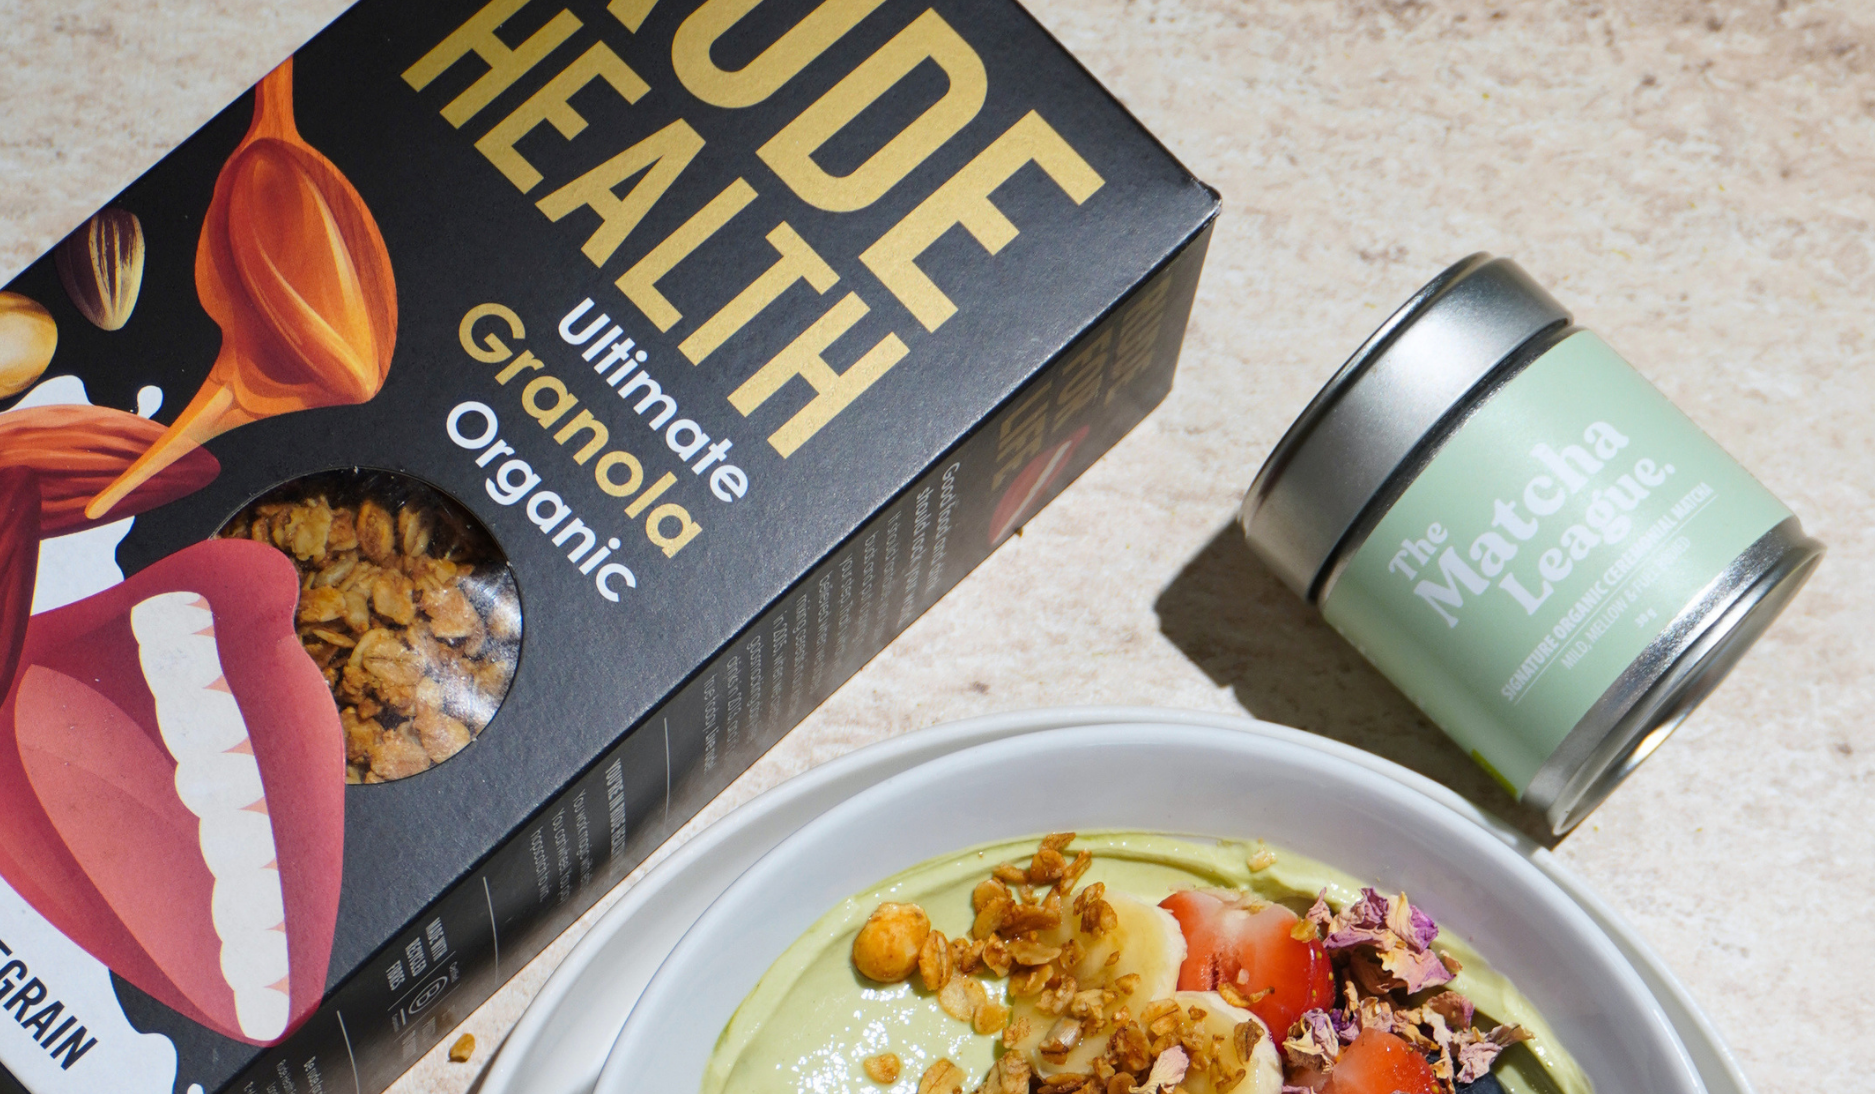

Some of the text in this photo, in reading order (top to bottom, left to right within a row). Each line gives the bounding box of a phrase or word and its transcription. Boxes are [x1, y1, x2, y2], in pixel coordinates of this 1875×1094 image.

[607, 0, 1104, 330] UDE
[402, 0, 910, 459] HEALTH
[460, 303, 700, 557] Granola
[559, 298, 747, 503] Ultimate
[1050, 324, 1113, 435] FOR
[938, 457, 960, 512] Good
[990, 378, 1052, 493] LIFE
[447, 401, 635, 602] Organic
[909, 527, 928, 568] rock
[911, 480, 934, 538] should
[933, 498, 955, 543] food
[1388, 521, 1448, 581] The
[1413, 421, 1629, 628] Matcha
[1498, 457, 1676, 616] League.
[1499, 480, 1714, 701] SIGNATURE ORGANIC CEREMONIAL MATCHA
[1560, 636, 1593, 670] MILD,
[1584, 597, 1628, 643] MELLOW
[1623, 587, 1639, 603] &
[608, 800, 625, 835] RUDE
[403, 935, 426, 980] RECYCLED
[424, 914, 447, 963] MADE WITH
